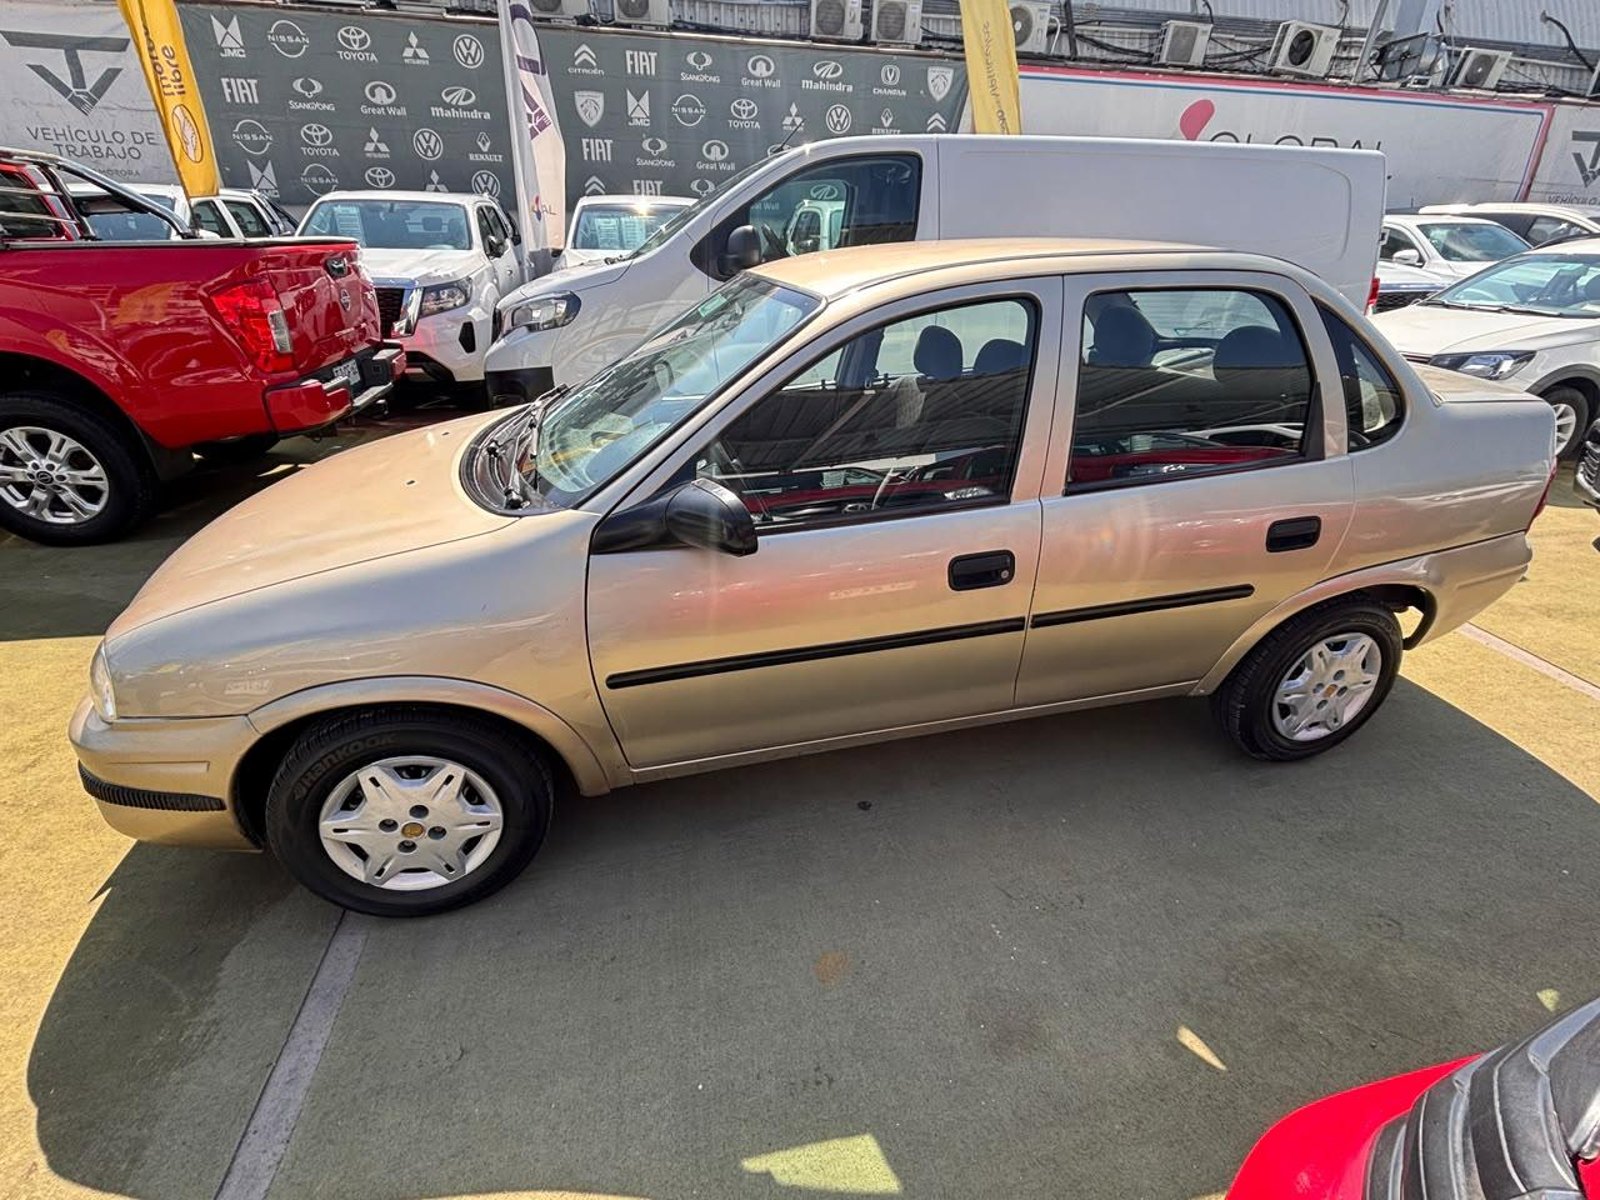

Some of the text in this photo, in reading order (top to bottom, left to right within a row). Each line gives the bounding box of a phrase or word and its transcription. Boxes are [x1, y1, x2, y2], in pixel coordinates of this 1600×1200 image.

[267, 34, 310, 44] NISSAN
[220, 48, 246, 58] JMC
[336, 50, 379, 63] TOYOTA
[625, 50, 658, 76] FIAT
[161, 45, 186, 96] libre
[741, 77, 781, 88] Great Wall
[801, 79, 853, 93] Mahindra
[220, 78, 259, 104] FIAT
[360, 105, 407, 116] Great Wall
[430, 106, 492, 120] Mahindra
[671, 106, 706, 115] NISSAN
[628, 118, 651, 127] JMC
[728, 119, 761, 129] TOYOTA
[26, 124, 159, 146] VEHÍCULO DE
[232, 133, 273, 141] NISSAN
[53, 143, 142, 160] TRABAJO
[300, 147, 340, 158] TOYOTA
[581, 138, 613, 162] FIAT
[469, 152, 503, 162] RENAULT
[696, 160, 736, 171] Great Wall
[300, 176, 339, 184] NISSAN
[633, 180, 664, 196] FIAT
